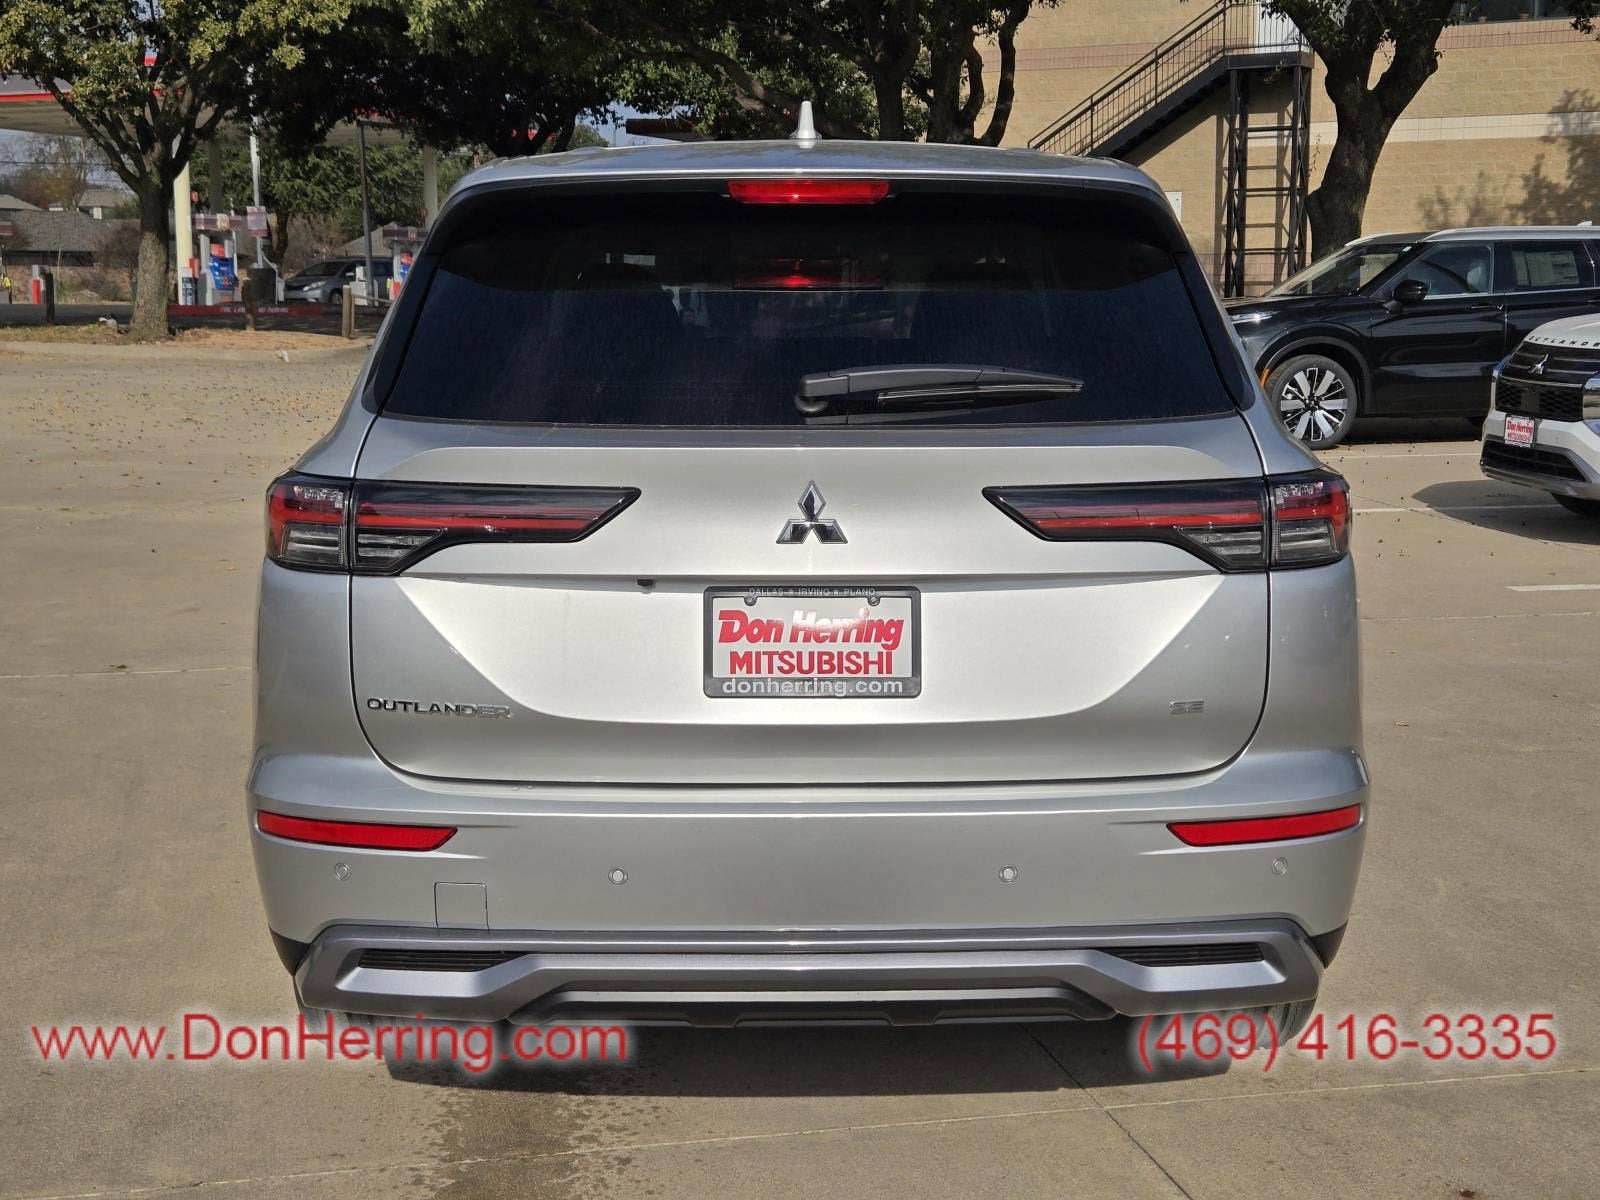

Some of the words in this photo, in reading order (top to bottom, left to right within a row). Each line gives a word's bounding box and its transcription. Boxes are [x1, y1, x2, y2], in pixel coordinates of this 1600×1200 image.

[749, 587, 783, 596] DALLAS
[798, 587, 829, 596] IRVING
[843, 587, 875, 596] PLANO
[718, 609, 785, 643] Don
[789, 607, 905, 651] Herring
[729, 650, 893, 675] MITSUBISHI
[722, 677, 903, 697] donherring.com
[366, 697, 513, 719] OUTLANDER
